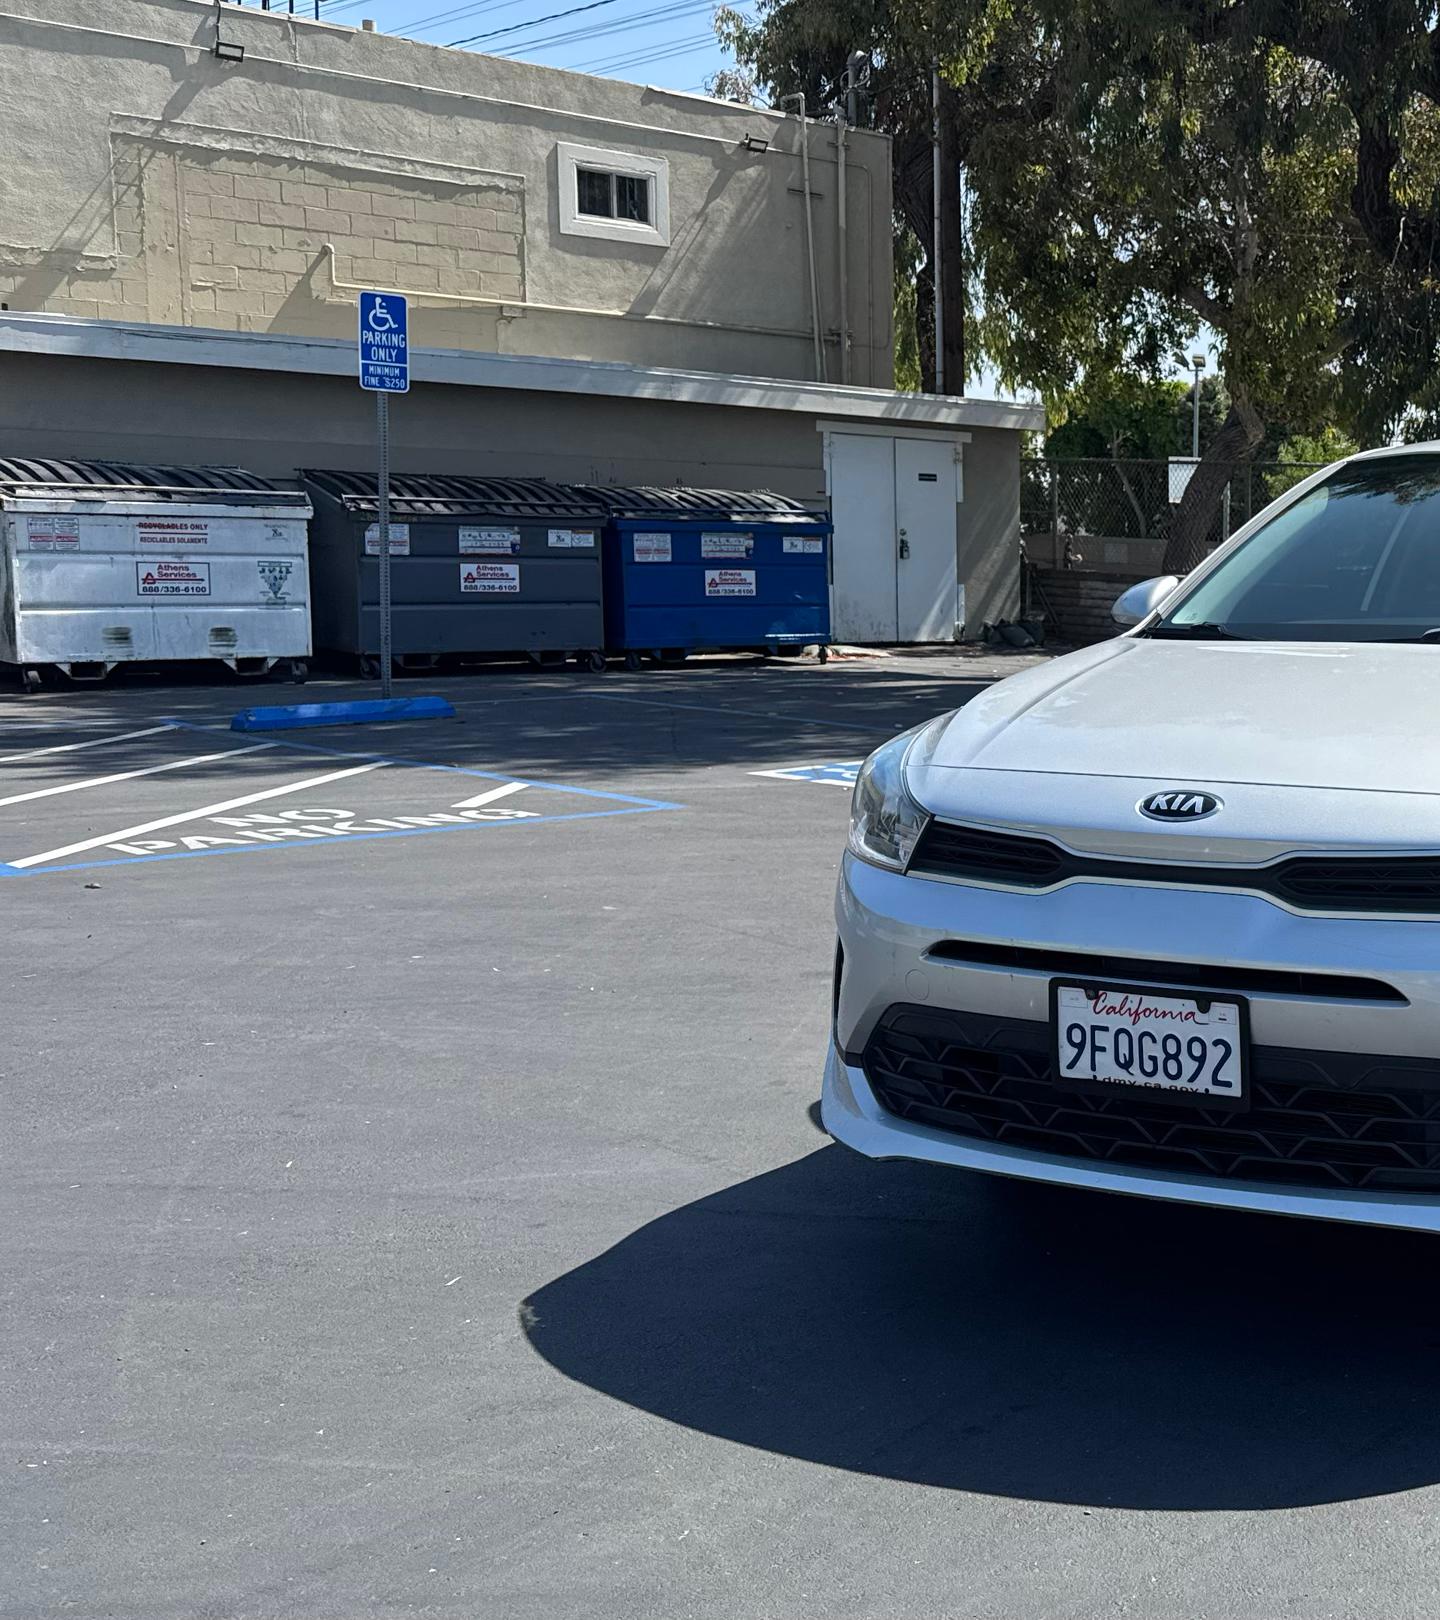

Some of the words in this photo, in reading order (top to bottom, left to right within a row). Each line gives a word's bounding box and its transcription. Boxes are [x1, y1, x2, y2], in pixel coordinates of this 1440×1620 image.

[362, 330, 406, 348] PARKING
[371, 346, 397, 362] ONLY
[368, 365, 400, 377] MINIMUM
[364, 376, 380, 387] FINE
[190, 523, 208, 531] ONLY
[157, 564, 190, 572] Athens
[1150, 793, 1205, 814] KIA
[205, 808, 356, 827] NO
[105, 808, 542, 856] PARKING
[1092, 991, 1210, 1026] California
[1066, 1022, 1233, 1089] 9FQG892
